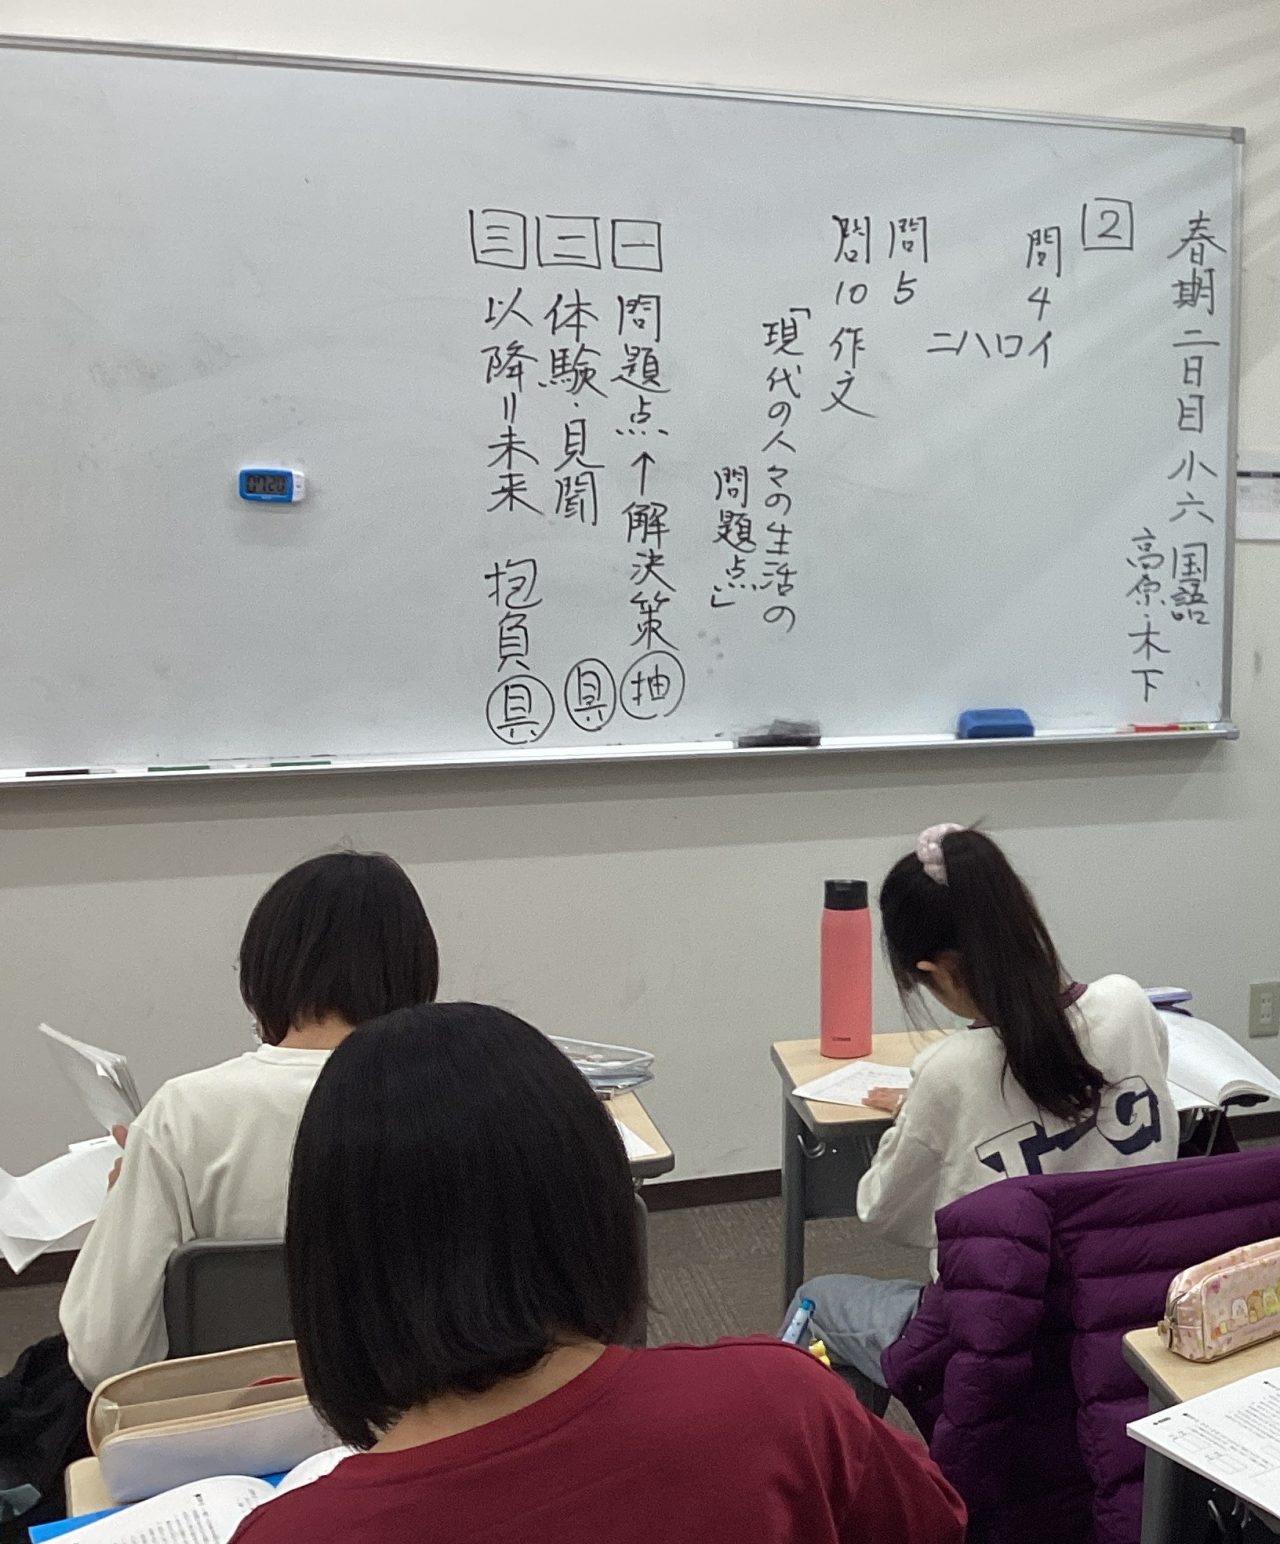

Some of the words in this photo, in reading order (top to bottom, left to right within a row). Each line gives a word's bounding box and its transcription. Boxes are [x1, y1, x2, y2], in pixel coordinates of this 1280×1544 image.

[610, 294, 672, 435] 問題点
[621, 501, 680, 651] 解決策
